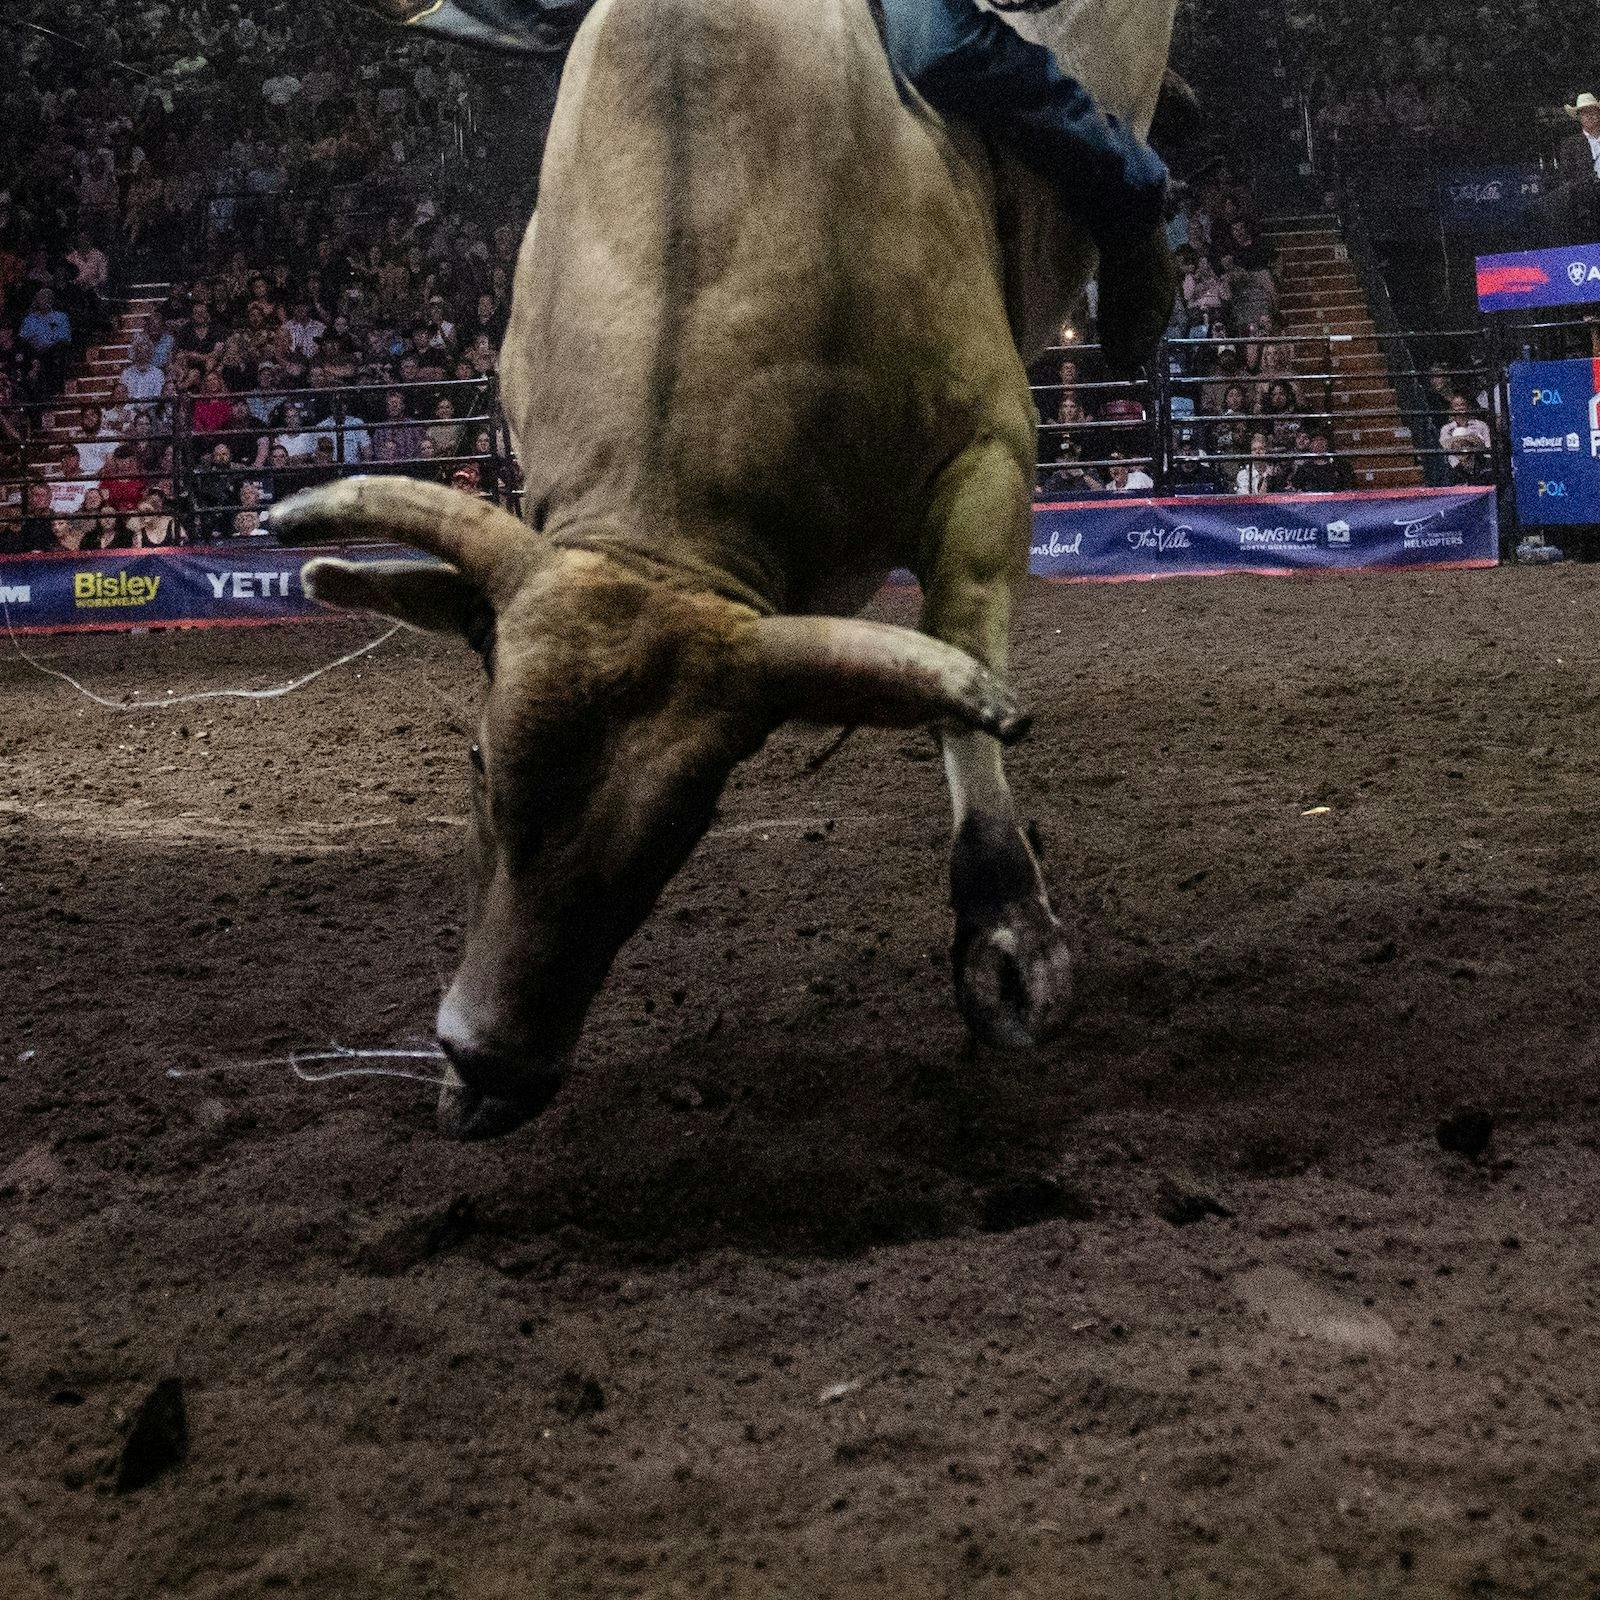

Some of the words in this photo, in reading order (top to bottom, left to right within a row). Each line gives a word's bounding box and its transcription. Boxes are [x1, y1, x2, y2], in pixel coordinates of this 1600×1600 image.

[1030, 531, 1082, 557] nsland
[1237, 525, 1318, 543] TOWNSVILLE
[74, 570, 161, 600] Bisley
[206, 572, 291, 598] YETI
